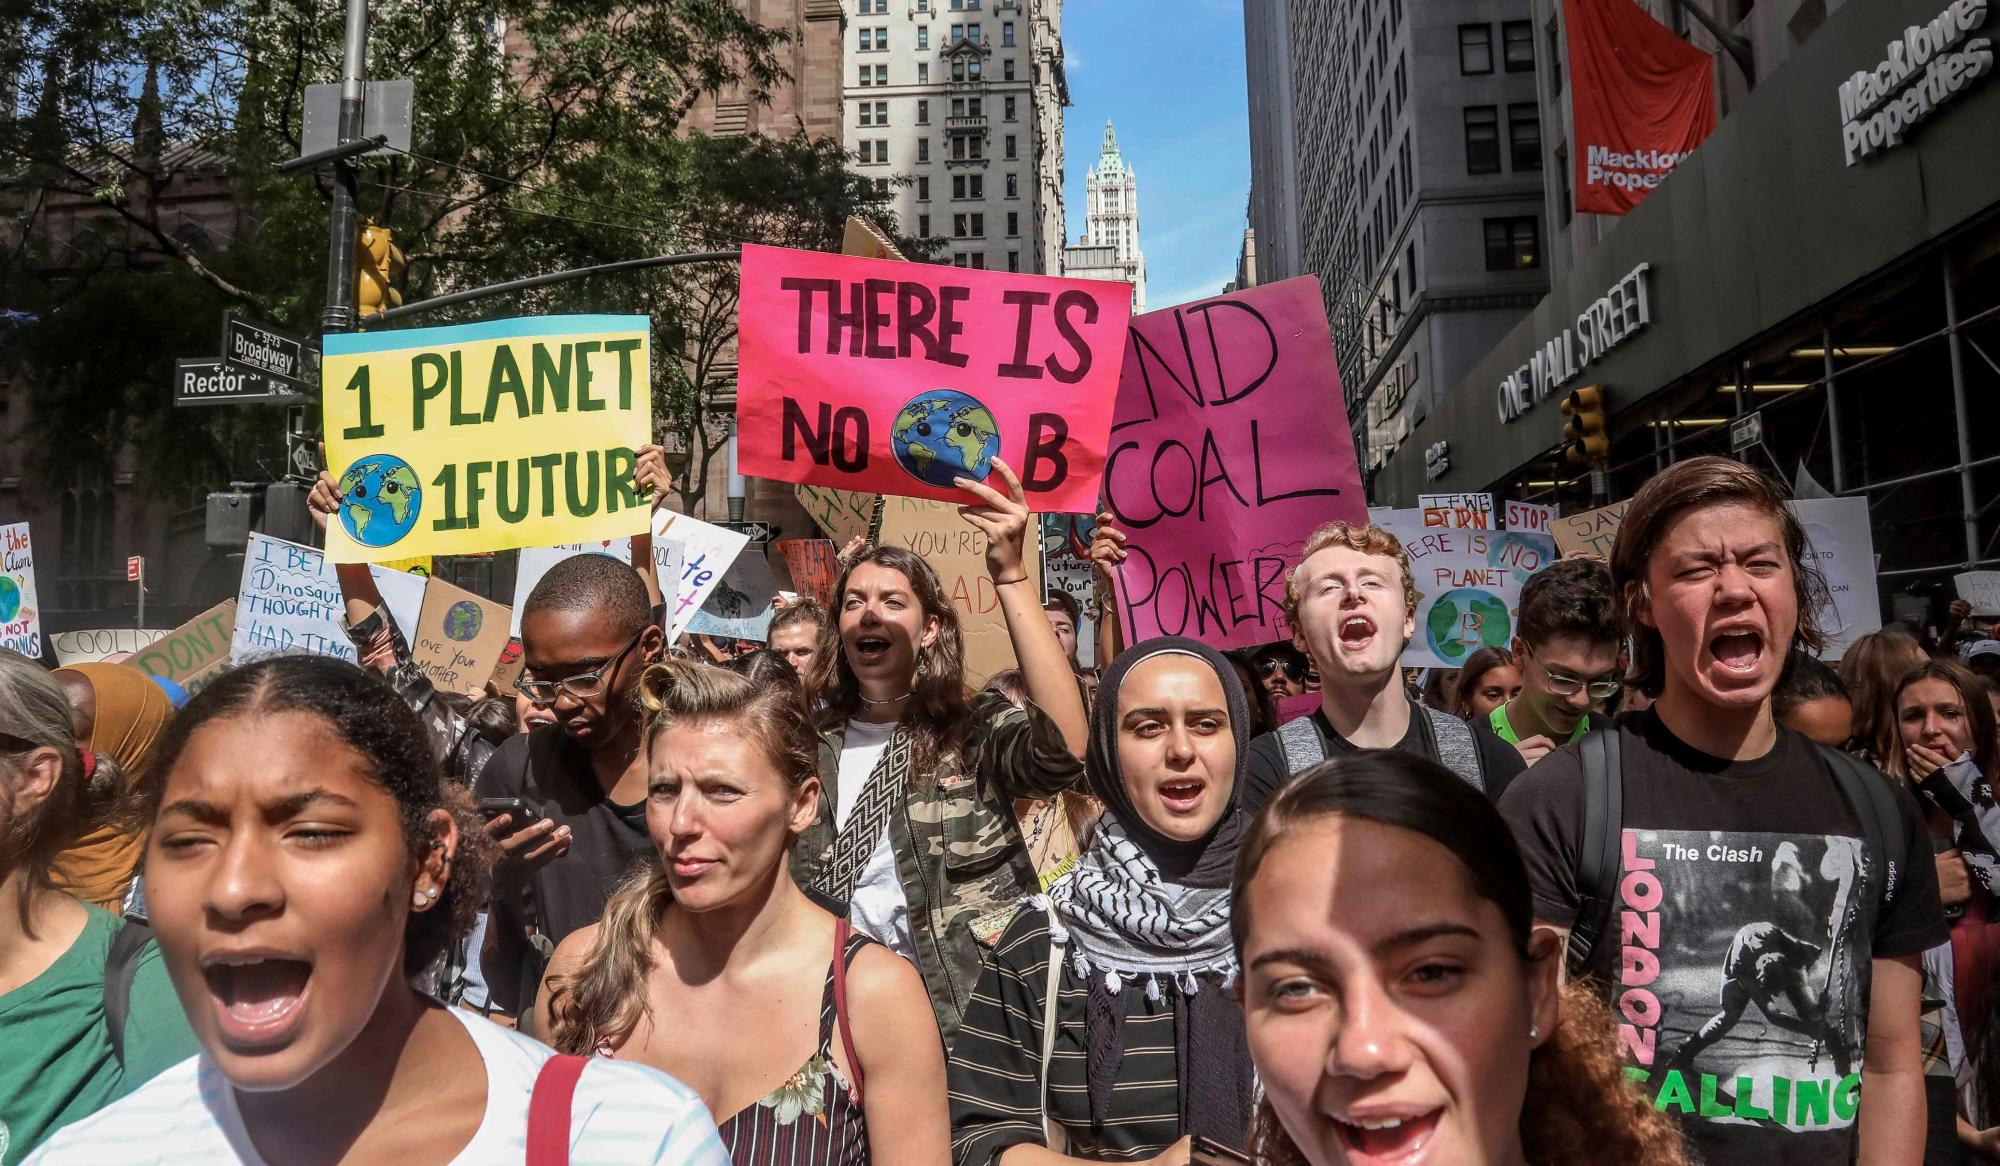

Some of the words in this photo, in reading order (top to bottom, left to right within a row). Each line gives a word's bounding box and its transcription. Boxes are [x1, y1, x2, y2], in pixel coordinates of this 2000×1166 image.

[1839, 0, 1987, 127] Macklowe
[1843, 38, 1993, 167] Properties
[781, 277, 970, 368] THERE
[997, 289, 1099, 384] IS
[1498, 364, 1531, 424] ONE
[1530, 329, 1580, 403] WALL
[1577, 262, 1650, 367] STREET
[235, 332, 294, 374] Broadway
[183, 371, 246, 394] Rector
[343, 364, 384, 440] 1
[412, 339, 641, 431] PLANET
[781, 396, 869, 473] NO
[1022, 412, 1069, 493] B
[1105, 420, 1341, 529] COAL
[1462, 493, 1492, 513] WE
[1508, 505, 1549, 532] STOP
[5, 527, 28, 551] the
[255, 540, 273, 563] I
[903, 531, 985, 557] YOU'RE
[1467, 534, 1488, 555] IS
[1500, 540, 1539, 571] NO
[1057, 576, 1092, 593] Your
[1433, 568, 1511, 588] PLANET
[242, 594, 334, 622] THOUGHT
[1117, 545, 1288, 647] POWER
[6, 620, 29, 636] NOT
[248, 620, 294, 651] HAD
[1455, 612, 1486, 645] B
[139, 611, 231, 678] DONT
[418, 660, 459, 690] MOTHER
[1663, 843, 1699, 862] The
[1707, 845, 1763, 863] Clash
[1886, 859, 1898, 891] adidas
[1617, 832, 1664, 1066] LONDON
